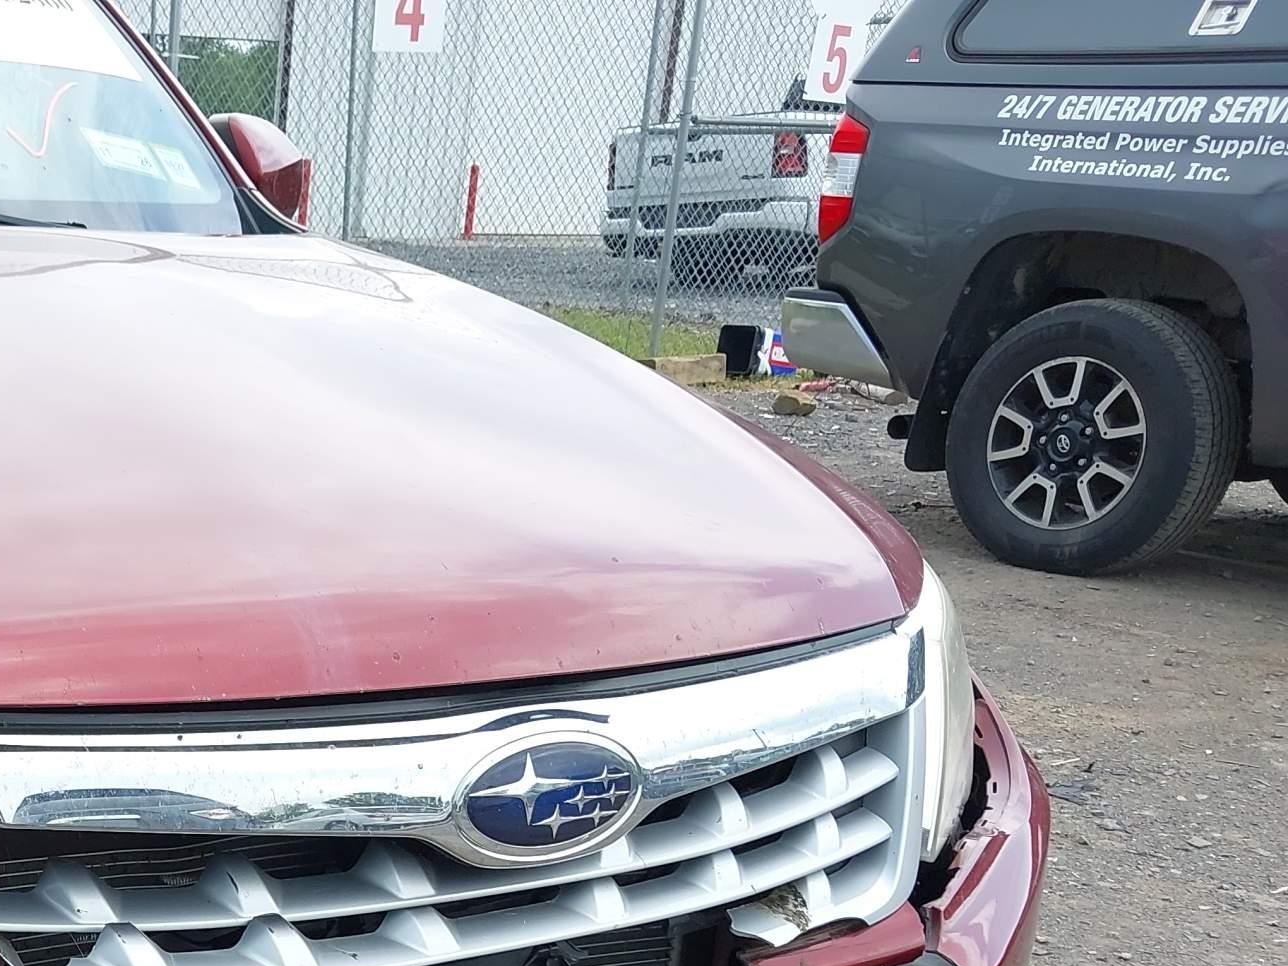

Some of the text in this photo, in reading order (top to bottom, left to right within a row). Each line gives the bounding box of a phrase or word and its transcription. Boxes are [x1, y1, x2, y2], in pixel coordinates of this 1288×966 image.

[394, 0, 426, 43] 4
[822, 24, 853, 94] 5
[997, 95, 1057, 120] 24/7
[1057, 95, 1208, 123] GENERATOR
[998, 129, 1111, 152] Integrated
[1114, 132, 1188, 154] Power
[1028, 155, 1231, 182] International, Inc.
